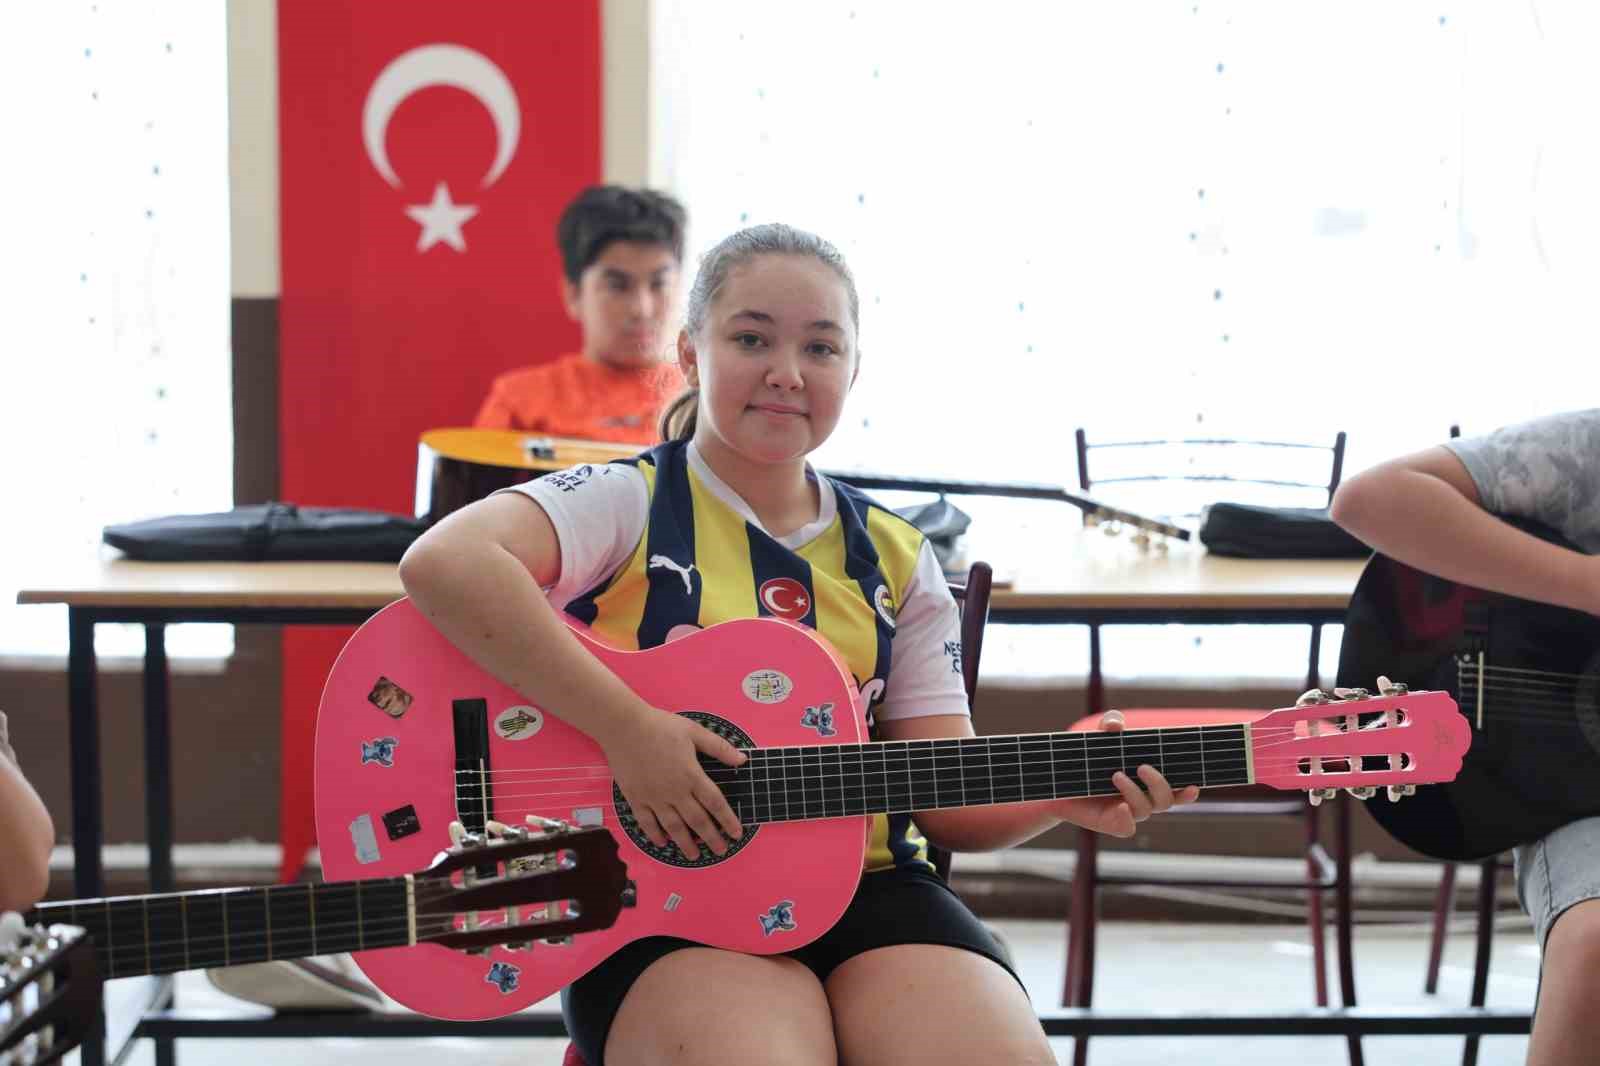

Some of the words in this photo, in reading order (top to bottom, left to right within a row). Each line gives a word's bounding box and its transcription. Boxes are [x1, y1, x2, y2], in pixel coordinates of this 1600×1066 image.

[543, 476, 576, 492] ORT
[552, 473, 586, 487] AFI
[943, 640, 961, 657] NES
